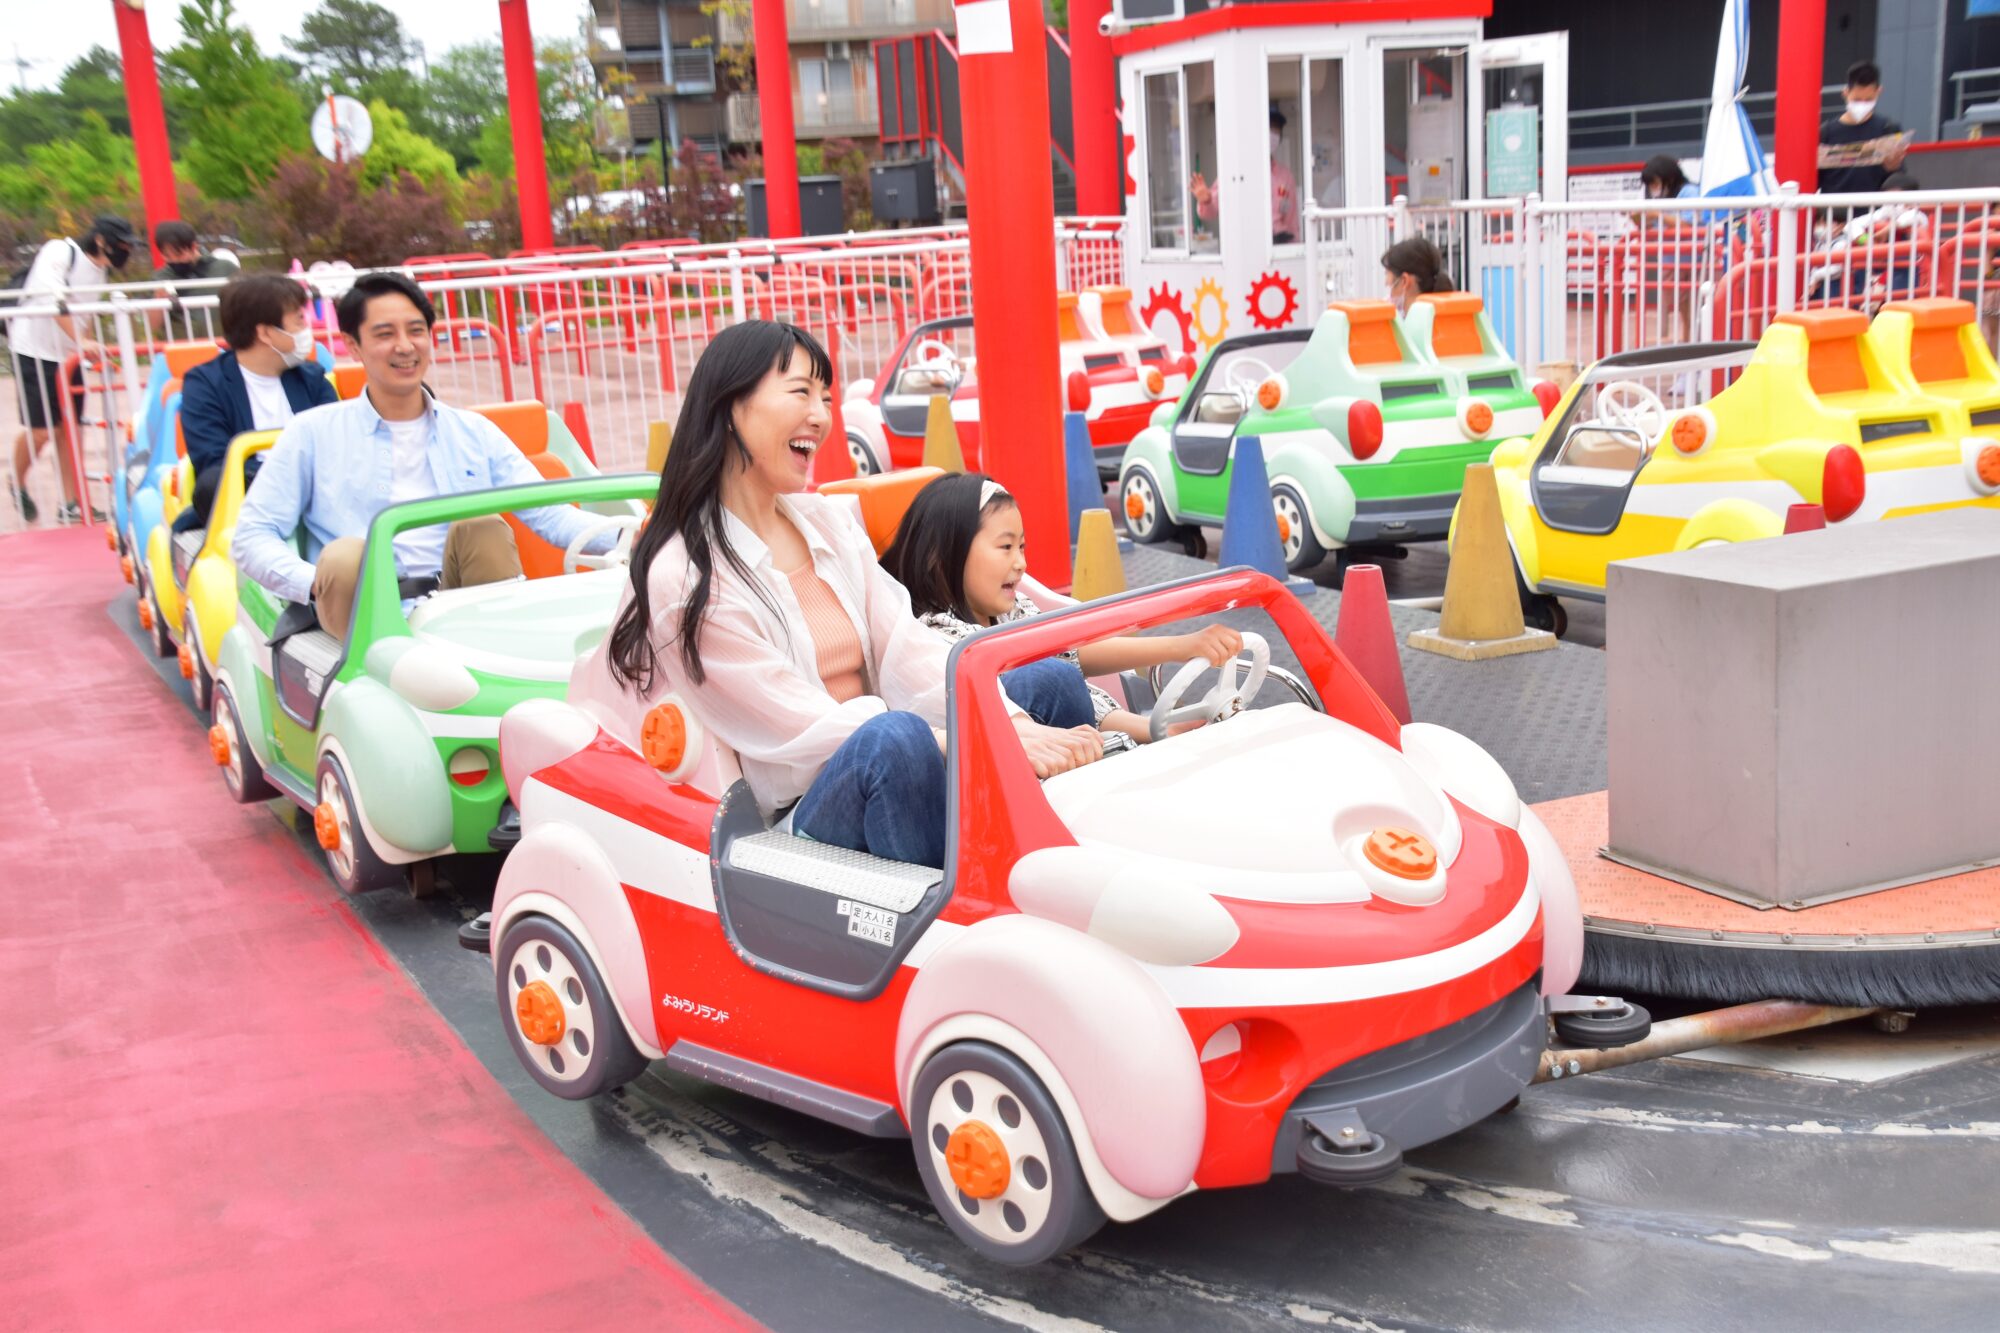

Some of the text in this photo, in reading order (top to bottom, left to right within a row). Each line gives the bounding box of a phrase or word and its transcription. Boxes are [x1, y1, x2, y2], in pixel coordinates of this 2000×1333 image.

[663, 993, 730, 1023] よみうりランド
